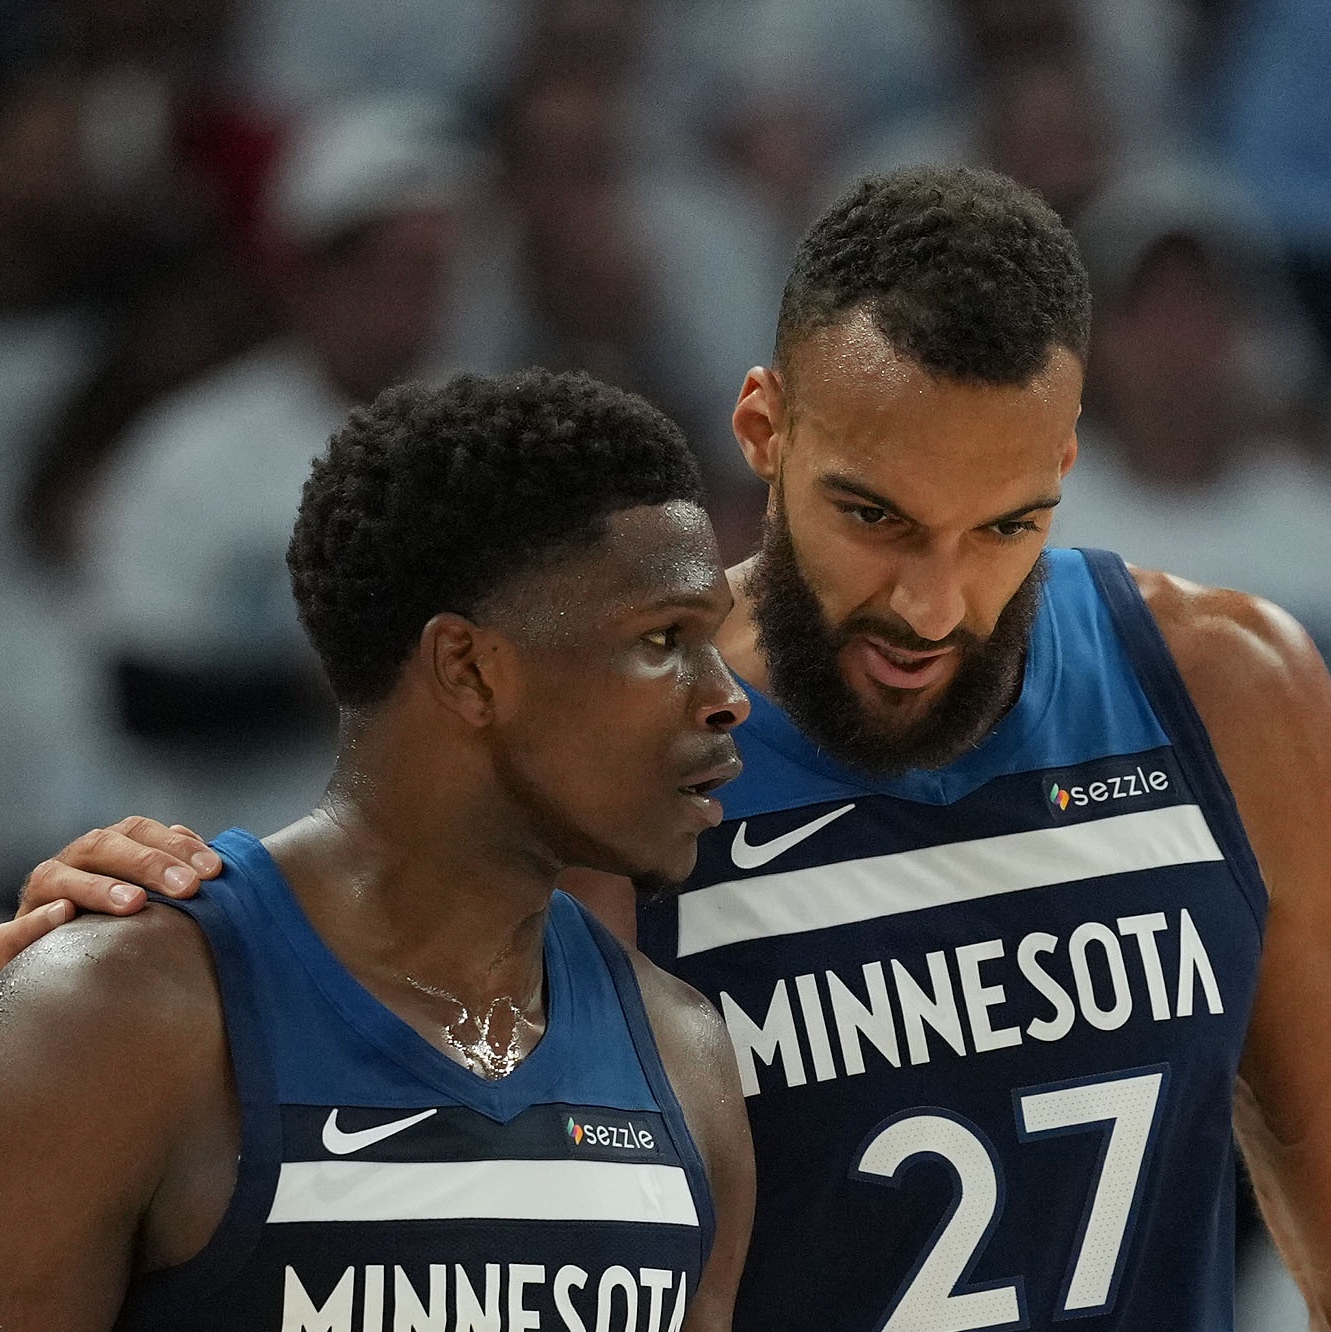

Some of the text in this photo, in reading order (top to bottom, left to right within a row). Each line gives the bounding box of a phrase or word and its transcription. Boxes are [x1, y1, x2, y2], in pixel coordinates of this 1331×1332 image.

[1070, 766, 1169, 806] sezzle
[720, 908, 1224, 1098] MINNESOTA
[583, 1121, 655, 1149] sezzle
